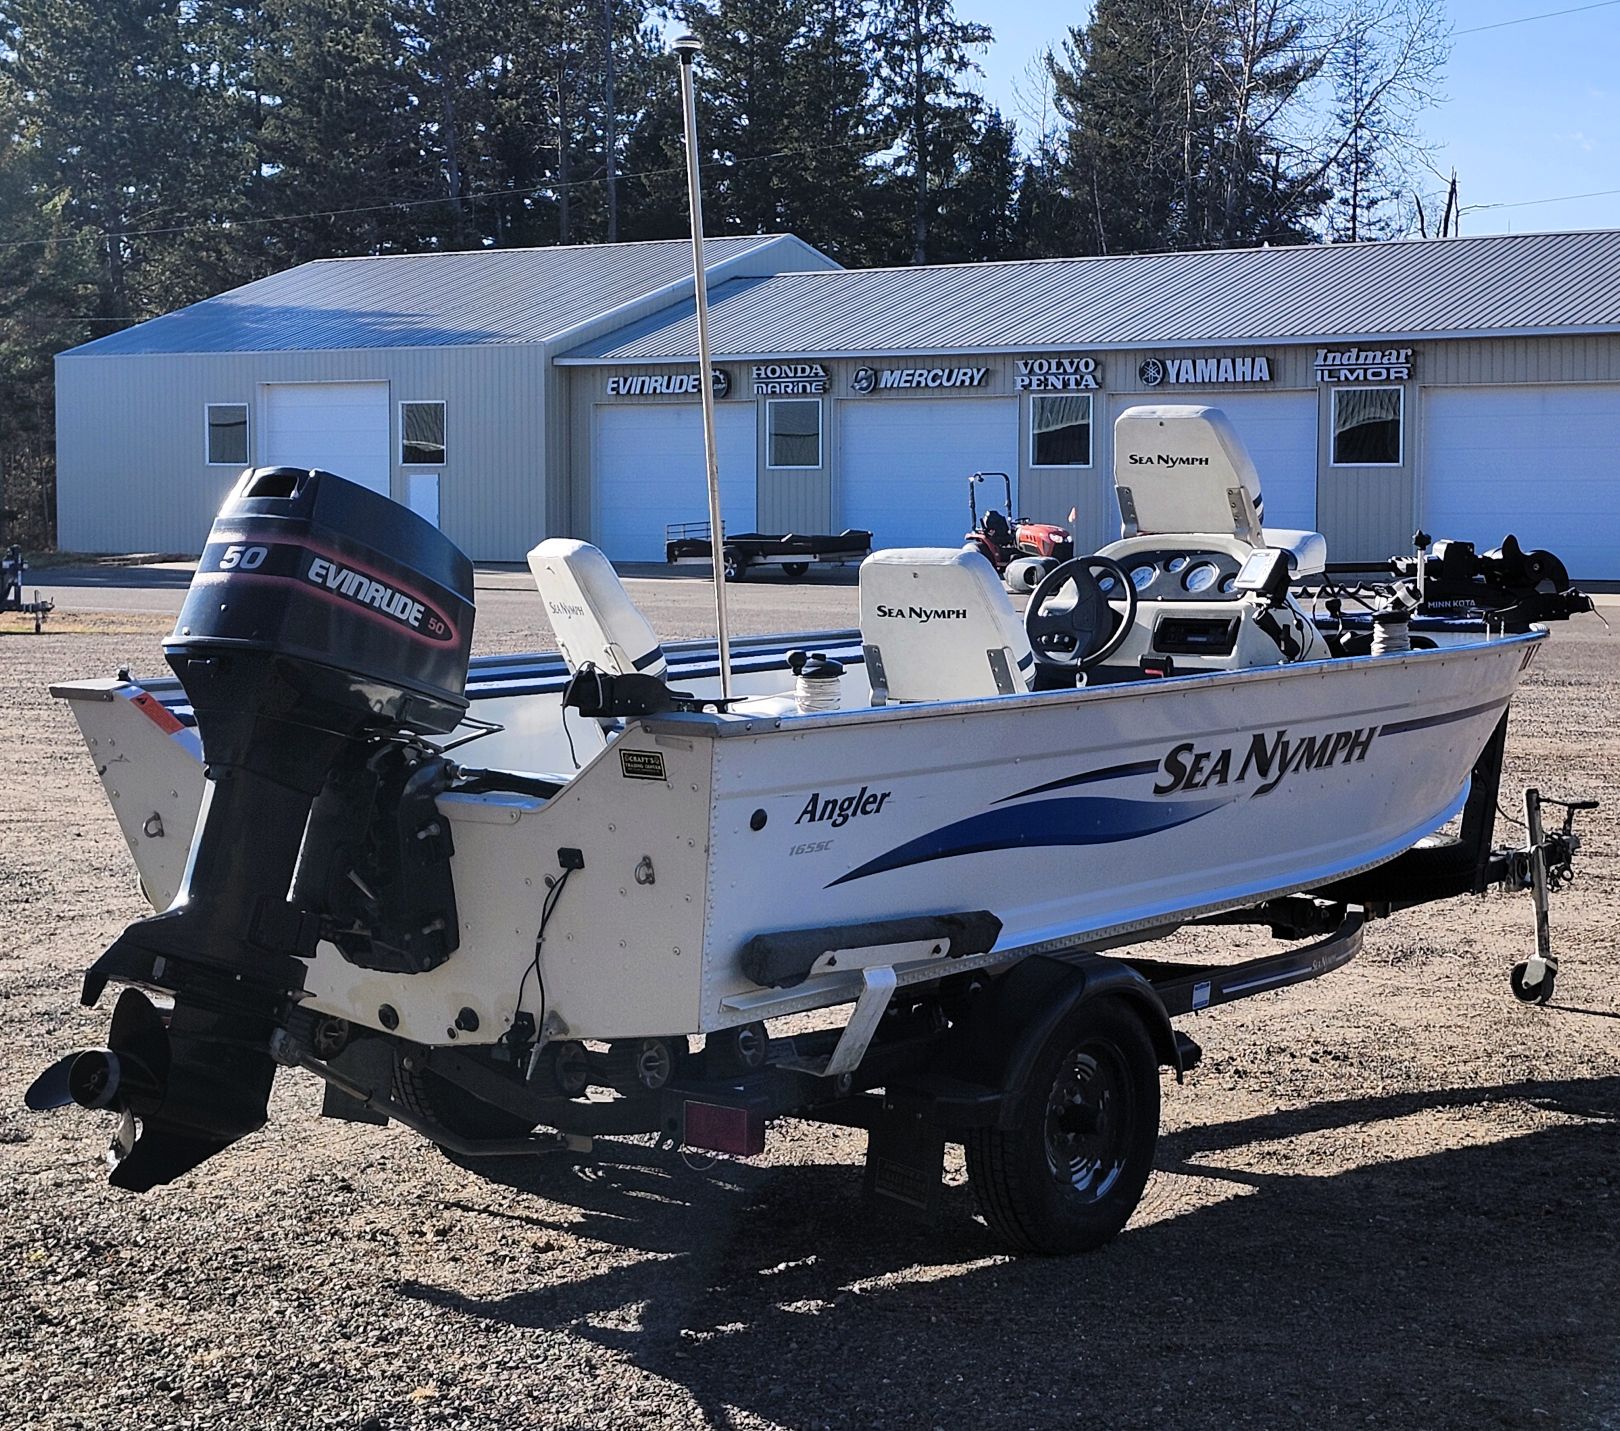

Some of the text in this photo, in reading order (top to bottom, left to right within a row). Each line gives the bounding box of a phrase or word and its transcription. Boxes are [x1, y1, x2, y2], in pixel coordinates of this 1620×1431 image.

[1314, 348, 1412, 365] Indmar
[751, 365, 826, 379] HONDA
[1015, 358, 1096, 374] VOLVO
[1165, 357, 1270, 383] YAMAHA
[1316, 367, 1409, 382] ILMOR
[606, 376, 700, 395] EVINRUDE
[880, 367, 985, 388] MERCURY
[1014, 375, 1099, 390] PENTA
[1129, 454, 1209, 468] SEA NYMPH
[219, 545, 267, 569] 50
[308, 557, 445, 635] EVINRUDE 50
[1428, 601, 1451, 609] MINN
[877, 605, 967, 623] SEA NYMPH
[1153, 727, 1376, 799] SEA NYMPH
[794, 785, 891, 828] Angler
